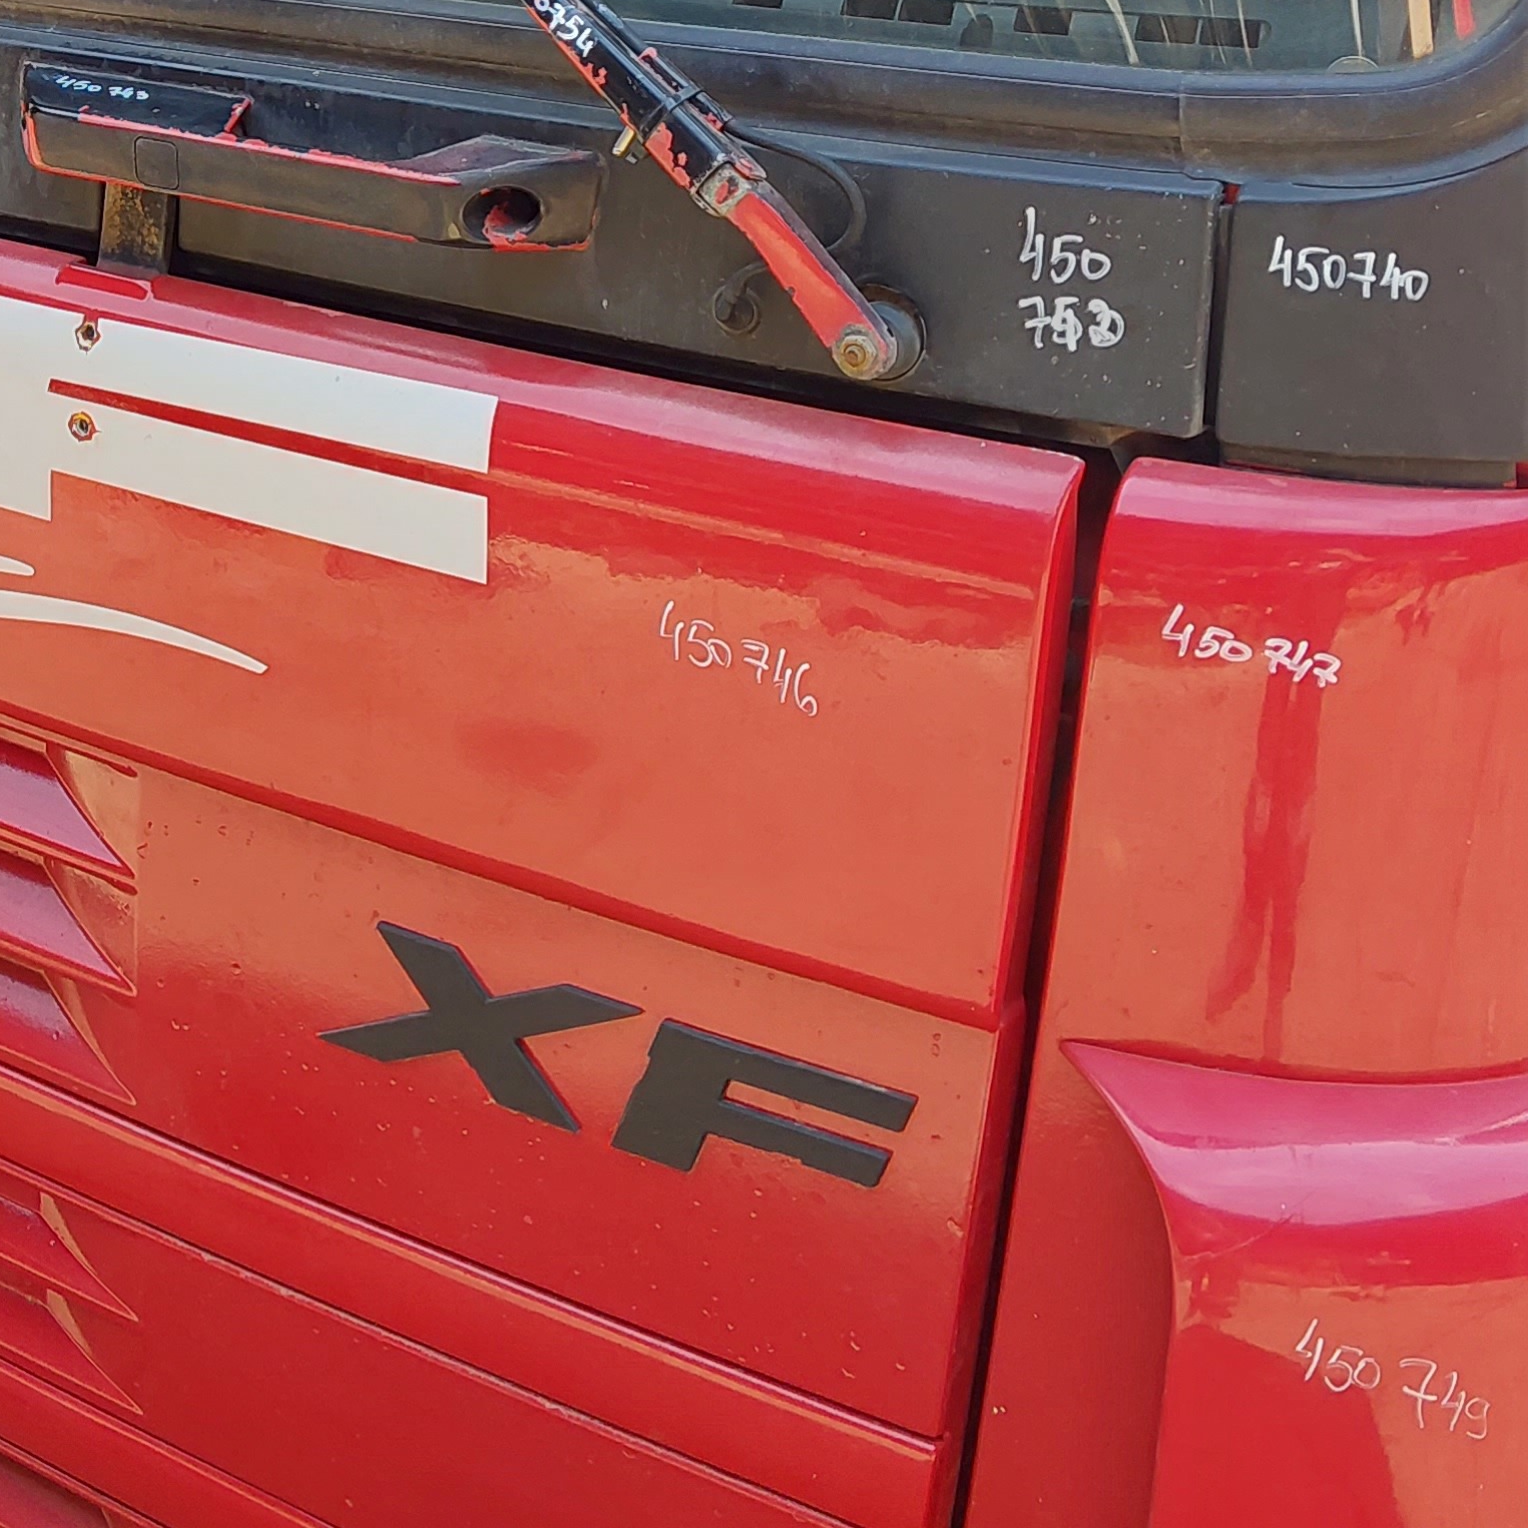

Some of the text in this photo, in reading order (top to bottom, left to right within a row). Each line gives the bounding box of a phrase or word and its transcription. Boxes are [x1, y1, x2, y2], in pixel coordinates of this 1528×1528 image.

[1019, 206, 1112, 284] 450
[1267, 235, 1429, 301] 450740
[659, 600, 818, 717] 450 746
[1162, 603, 1341, 688] 450 747
[318, 920, 918, 1189] XF
[1295, 1318, 1490, 1440] 450 749
